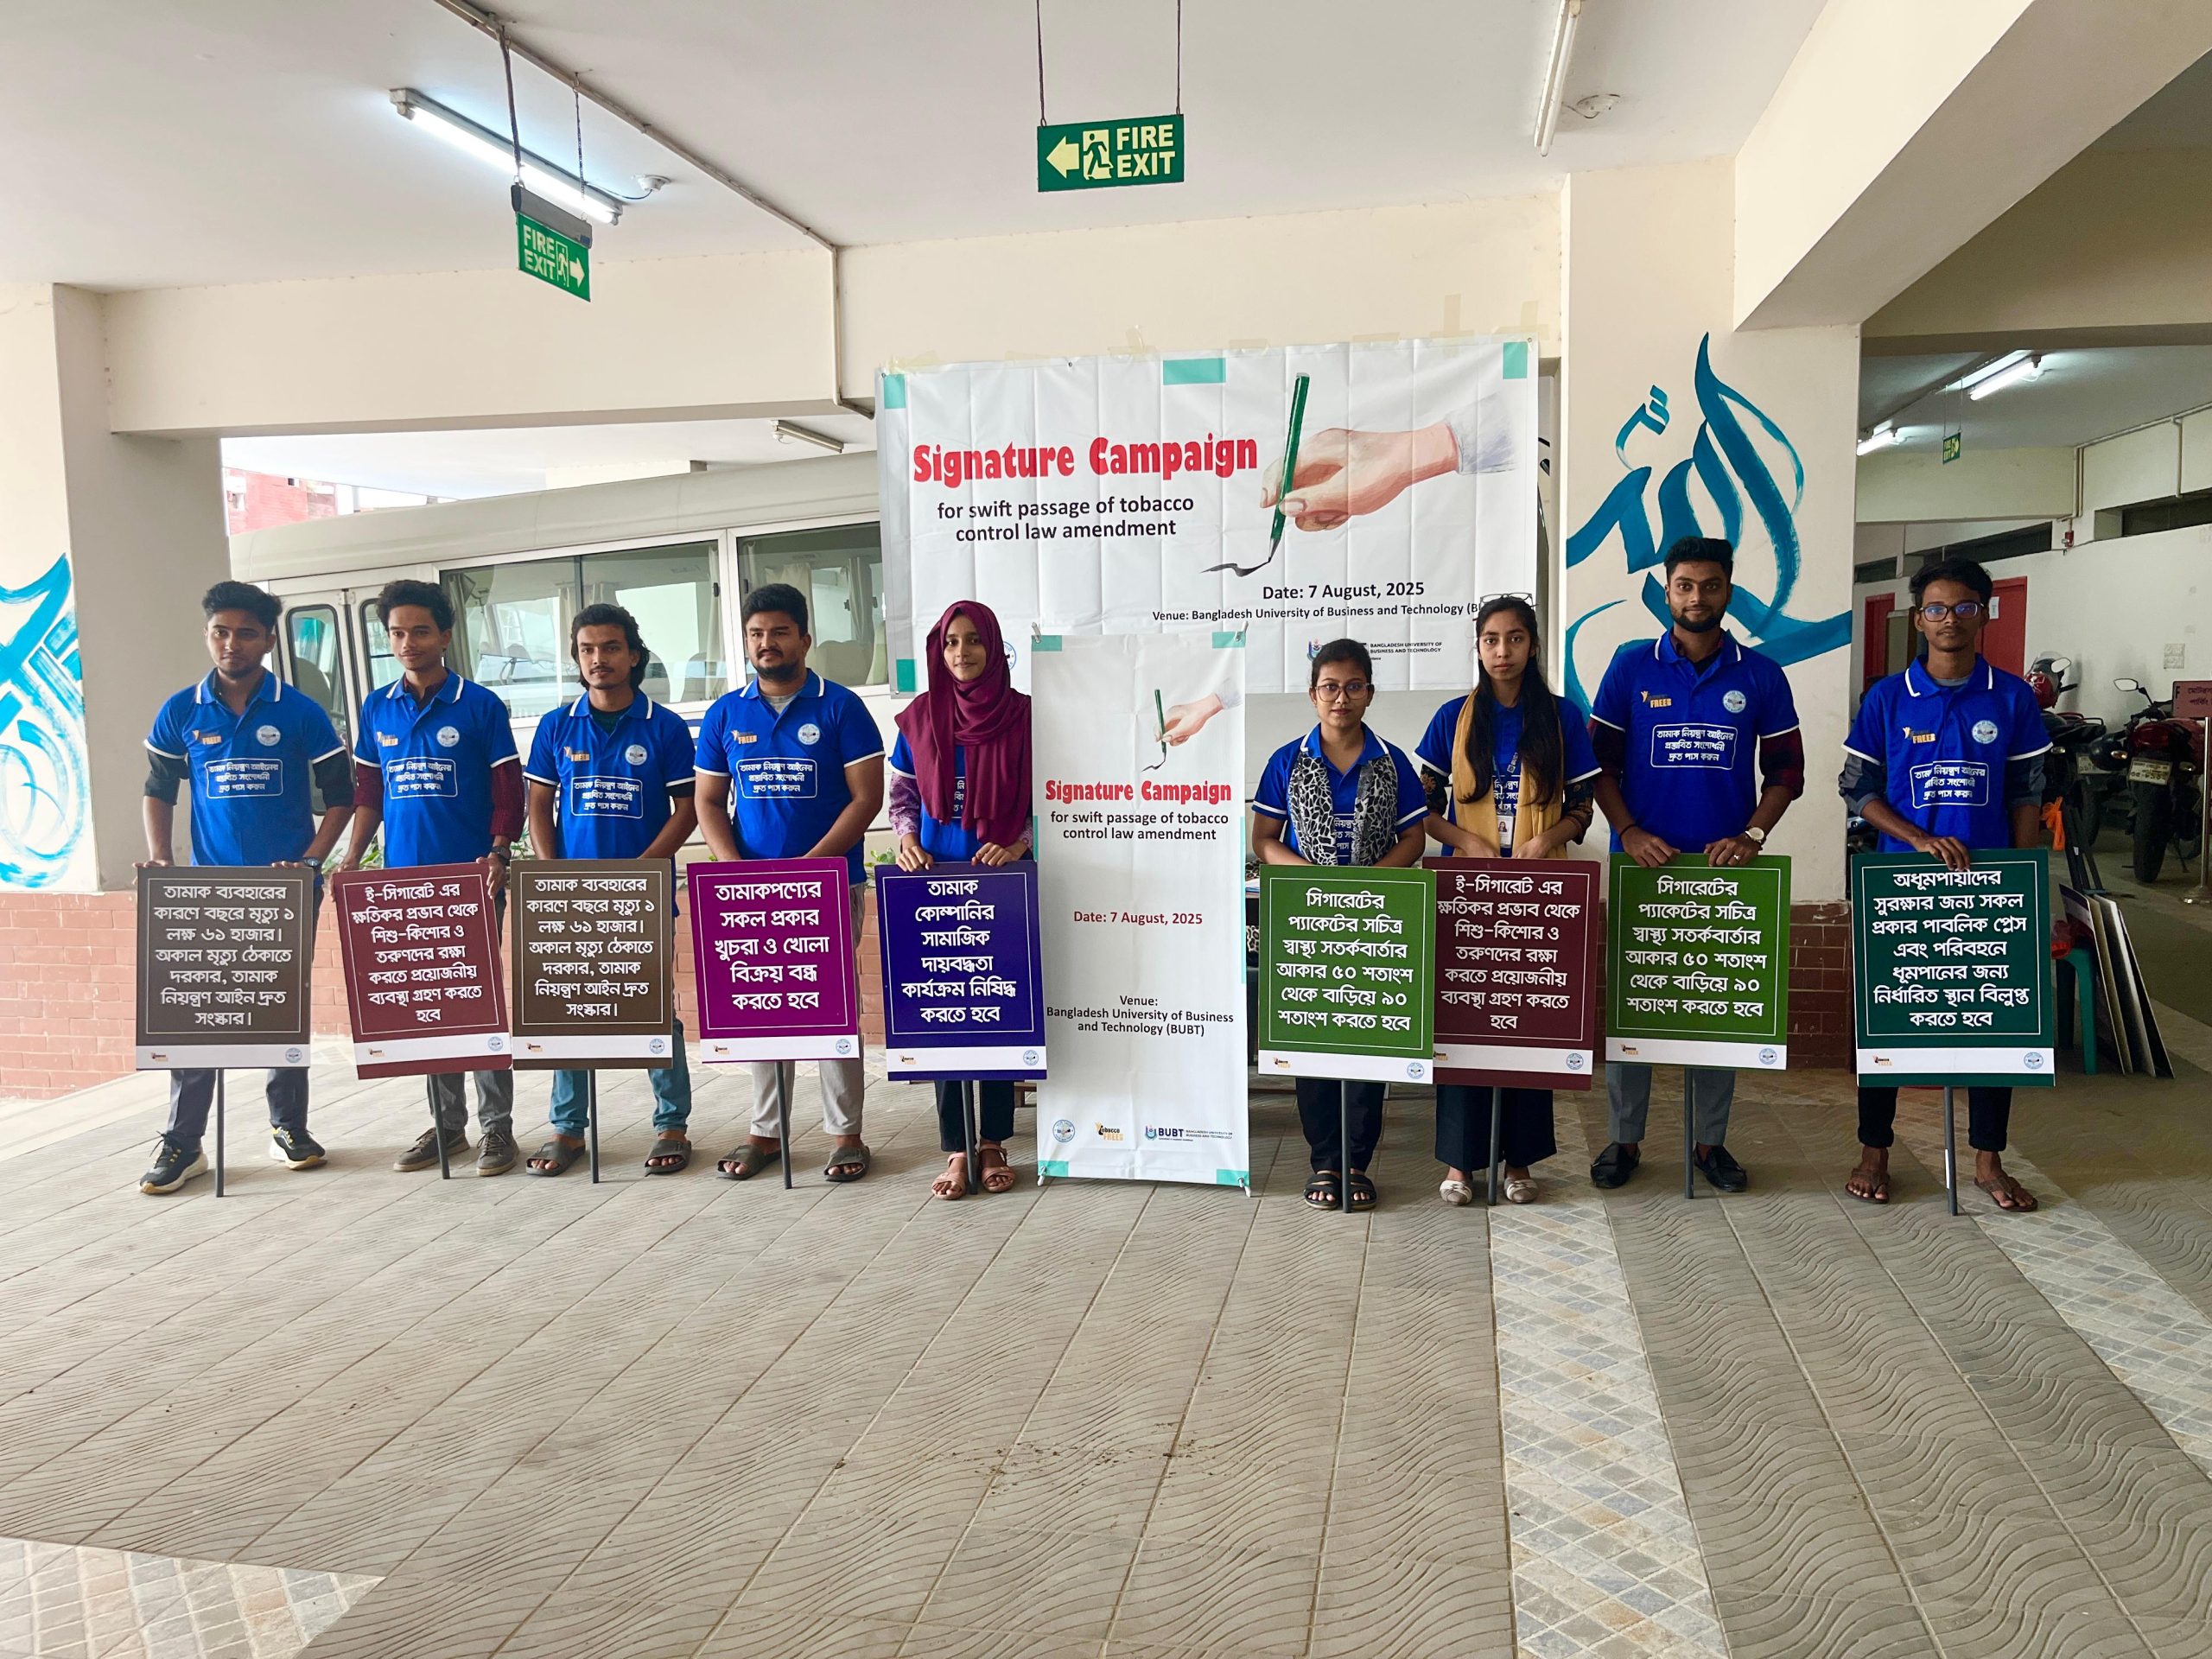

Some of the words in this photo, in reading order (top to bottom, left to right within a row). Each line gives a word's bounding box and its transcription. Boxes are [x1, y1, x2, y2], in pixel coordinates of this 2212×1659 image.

[1116, 124, 1174, 151] FIRE
[1116, 150, 1176, 179] EXIT
[523, 225, 555, 260] FIRE
[524, 248, 556, 281] EXIT
[913, 442, 1074, 488] Signature
[1090, 432, 1257, 480] Campaign
[938, 502, 963, 518] for
[969, 500, 1012, 518] swift
[1018, 502, 1090, 520] passage
[1096, 496, 1115, 513] of
[1120, 495, 1193, 512] tobacco
[957, 523, 1019, 542] control
[1026, 523, 1057, 539] law
[1063, 519, 1176, 538] amendment
[1263, 587, 1303, 600] Date:
[1308, 585, 1318, 598] 7
[1322, 584, 1381, 601] August,
[1386, 582, 1424, 596] 2025
[1153, 612, 1189, 620] Venue:
[1192, 608, 1252, 621] Bangladesh
[1255, 607, 1310, 620] University
[1313, 607, 1325, 617] of
[1327, 607, 1374, 616] Business
[1377, 605, 1397, 615] and
[1401, 603, 1464, 615] Technology
[1046, 779, 1134, 804] Signature
[1141, 780, 1231, 804] Campaign
[1050, 810, 1069, 823] for
[1072, 810, 1103, 823] swift
[1107, 813, 1157, 827] passage
[1160, 811, 1174, 823] of
[1178, 811, 1229, 823] tobacco
[1063, 827, 1108, 840] control
[1110, 827, 1134, 840] law
[1137, 828, 1217, 840] amendment
[162, 886, 212, 899] তামাক
[215, 887, 287, 899] ব্যবহারের
[365, 882, 435, 903] ই-সিগারেট
[439, 884, 460, 896] এর
[714, 881, 822, 900] তামাকপণ্যের
[926, 880, 979, 896] তামাক
[1656, 875, 1738, 896] সিগারেটের
[1306, 887, 1385, 909] সিগারেটের
[1873, 896, 1935, 916] সুরক্ষার
[1938, 895, 1975, 910] জন্য
[1979, 893, 2024, 908] সকল
[153, 907, 200, 920] কারণে
[203, 907, 245, 922] বছরে
[248, 907, 280, 925] মৃত্যু
[284, 908, 294, 920] ১
[351, 906, 403, 924] ক্ষতিকর
[406, 906, 443, 919] প্রভাব
[448, 903, 479, 917] থেকে
[720, 911, 766, 928] সকল
[771, 909, 819, 926] প্রকার
[915, 899, 995, 921] কোম্পানির
[1074, 911, 1106, 923] Date:
[1110, 912, 1117, 923] 7
[1121, 912, 1168, 925] August,
[1172, 913, 1203, 925] 2025
[1638, 901, 1711, 919] প্যাকেটের
[1714, 900, 1757, 921] সচিত্র
[371, 924, 450, 944] শিশু-কিশোর
[454, 925, 464, 938] ও
[1288, 913, 1359, 932] প্যাকেটের
[1362, 913, 1403, 934] সচিত্র
[1872, 920, 1918, 934] প্রকার
[1923, 913, 1988, 933] পাবলিক
[1993, 915, 2027, 933] প্লেস
[166, 928, 197, 940] লক্ষ
[200, 928, 226, 941] ৬১
[230, 928, 282, 942] হাজার।
[920, 925, 990, 946] সামাজিক
[155, 950, 203, 962] অকাল
[206, 950, 238, 966] মৃত্যু
[242, 944, 293, 963] ঠেকাতে
[374, 948, 434, 963] তরুণদের
[436, 945, 466, 959] রক্ষা
[715, 939, 759, 961] খুচরা
[763, 938, 777, 954] ও
[783, 937, 830, 954] খোলা
[1282, 939, 1317, 959] স্বাস্থ্য
[1320, 938, 1408, 958] সতর্কবার্তার
[1893, 943, 1929, 958] এবং
[1933, 937, 2007, 957] পরিবহনে
[368, 970, 408, 984] করতে
[410, 961, 477, 982] প্রয়োজনীয়
[729, 960, 784, 983] বিক্রয়
[787, 964, 817, 982] বন্ধ
[921, 956, 994, 973] দায়বদ্ধতা
[1276, 963, 1327, 978] আকার
[1332, 966, 1357, 979] ৫০
[1362, 967, 1414, 984] শতাংশ
[1892, 965, 1968, 984] ধূমপানের
[1972, 965, 2009, 979] জন্য
[169, 970, 226, 985] দরকার,
[231, 970, 278, 982] তামাক
[901, 978, 965, 998] কার্যক্রম
[969, 976, 1016, 997] নিষিদ্ধ
[160, 987, 212, 1007] নিয়ন্ত্রণ
[215, 988, 256, 1005] আইন
[257, 991, 287, 1006] দ্রুত
[368, 990, 410, 1007] ব্যবস্থা
[412, 988, 442, 1001] গ্রহণ
[444, 985, 482, 1000] করতে
[732, 993, 783, 1010] করতে
[786, 992, 819, 1009] হবে
[1119, 995, 1158, 1006] Venue:
[1281, 987, 1319, 1002] থেকে
[1322, 984, 1376, 1006] বাড়িয়ে
[1382, 992, 1407, 1006] ৯০
[1873, 984, 1939, 1003] নির্ধারিত
[1943, 988, 1975, 1007] স্থান
[1979, 983, 2030, 1007] বিলুপ্ত
[194, 1012, 251, 1027] সংস্কার।
[416, 1008, 441, 1022] হবে
[920, 1007, 967, 1023] করতে
[969, 1007, 1001, 1023] হবে
[1047, 1007, 1109, 1020] Bangladesh
[1112, 1008, 1168, 1022] University
[1171, 1010, 1183, 1020] of
[1185, 1011, 1234, 1022] Business
[1278, 1010, 1328, 1027] শতাংশ
[1332, 1013, 1377, 1029] করতে
[1381, 1015, 1411, 1031] হবে
[1909, 1012, 1957, 1027] করতে
[1961, 1012, 1993, 1027] হবে
[1077, 1020, 1098, 1033] and
[1101, 1021, 1163, 1036] Technology
[1166, 1023, 1205, 1037] (BUBT)
[1159, 1128, 1184, 1137] BUBT
